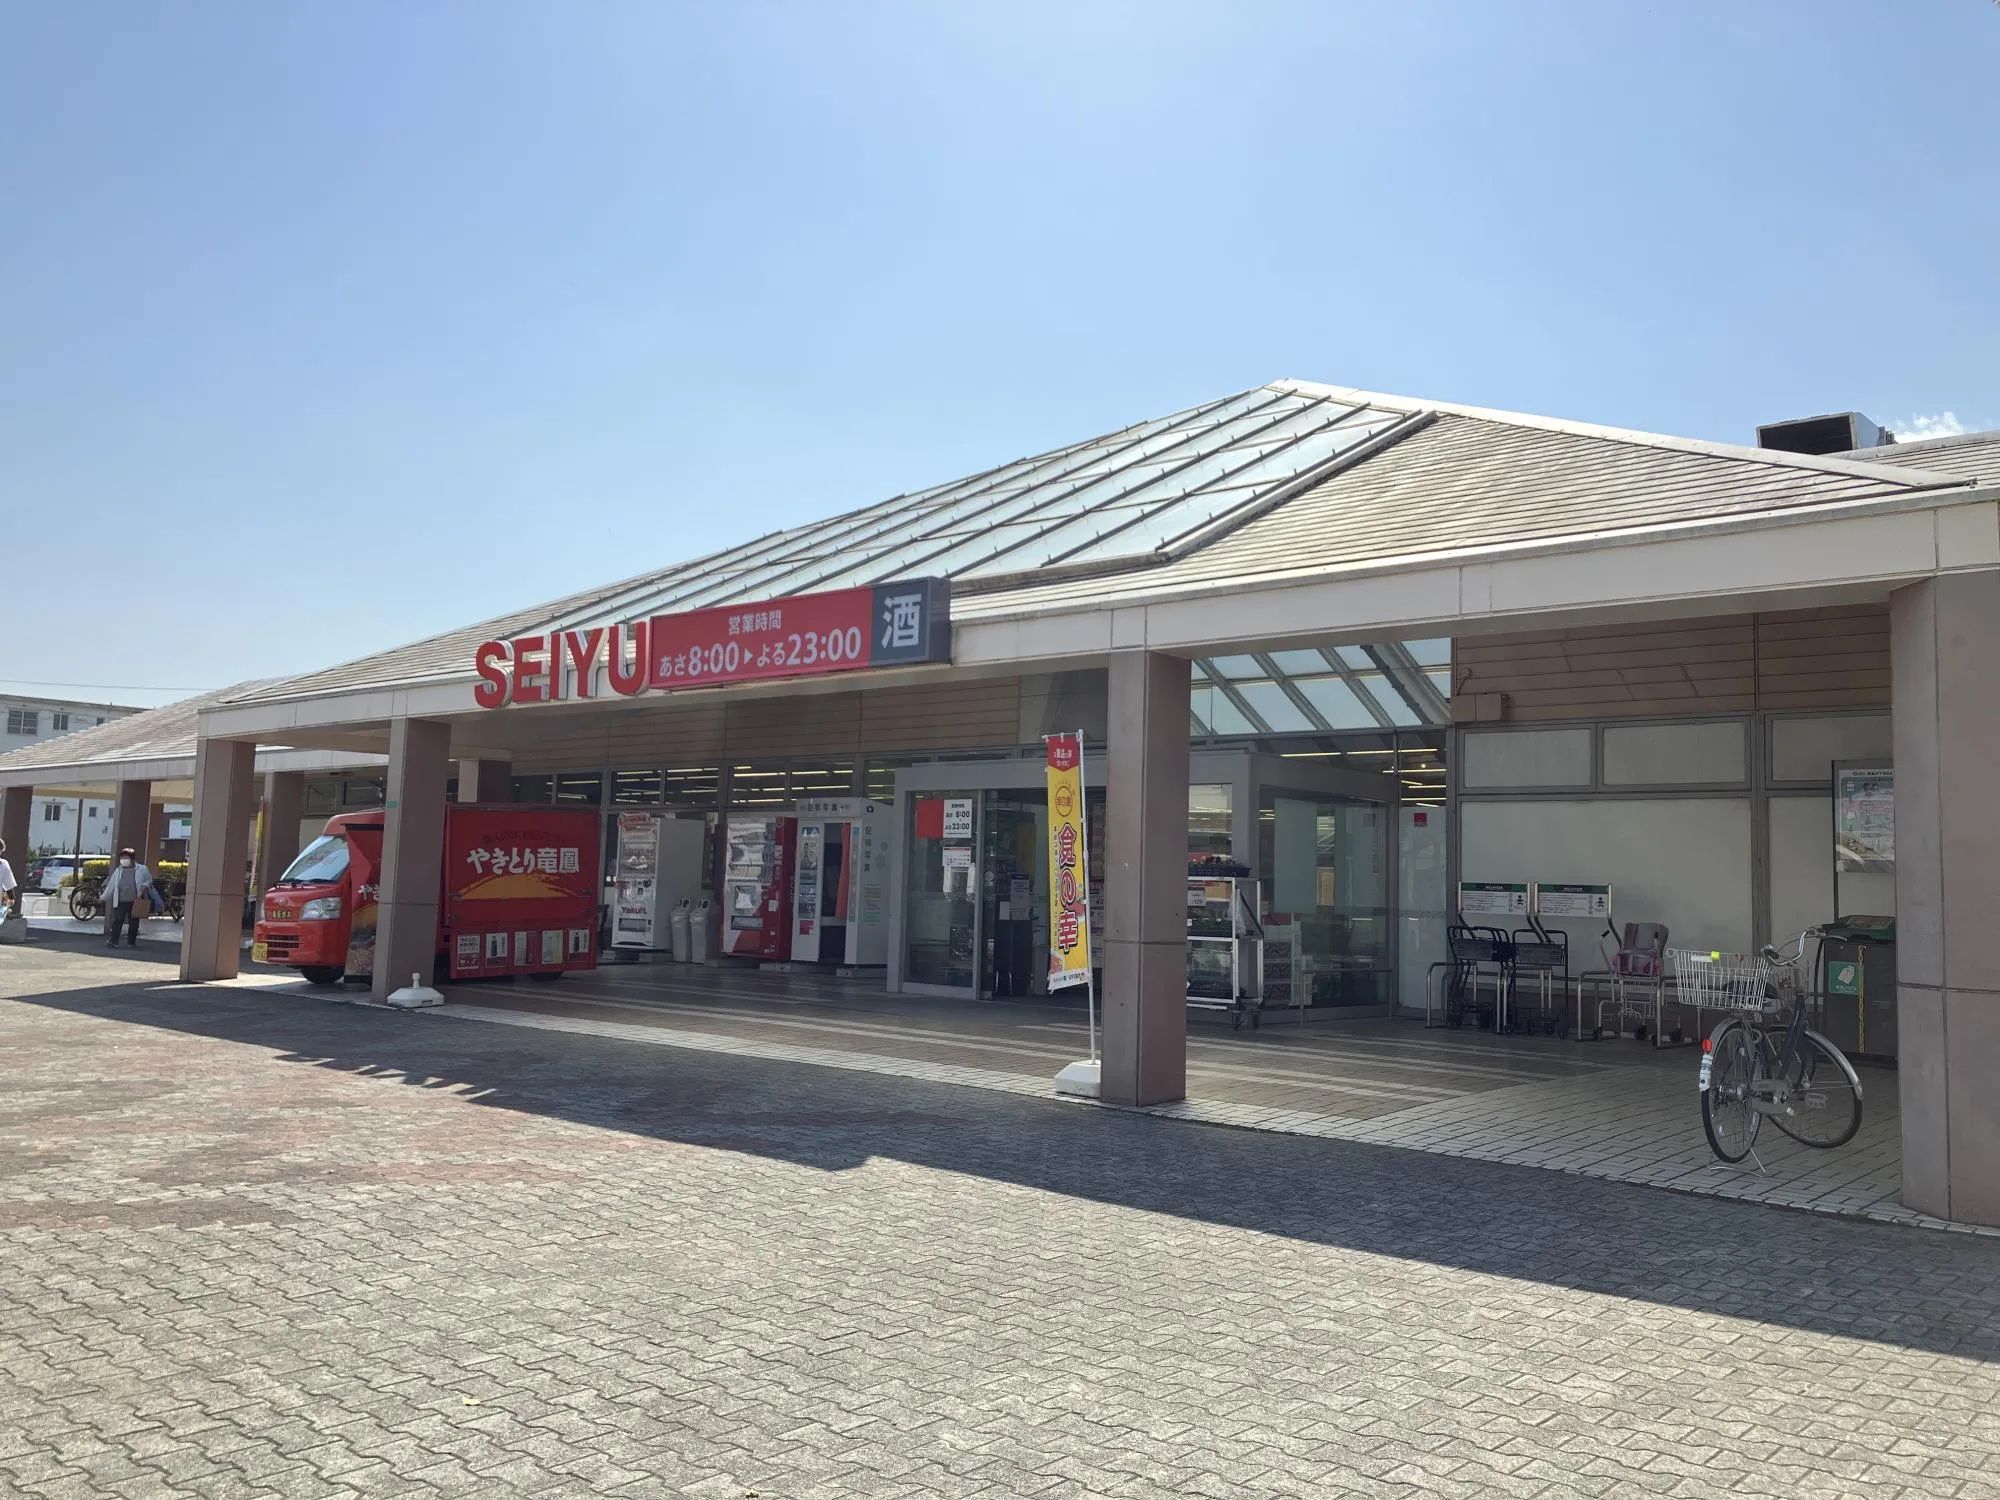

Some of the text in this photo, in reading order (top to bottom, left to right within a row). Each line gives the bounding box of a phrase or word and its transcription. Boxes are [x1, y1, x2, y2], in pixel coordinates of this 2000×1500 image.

[728, 610, 782, 636] 営業時間
[881, 593, 921, 648] 酒
[474, 621, 648, 709] SEIYU
[466, 847, 580, 875] やきとり竜鳳
[621, 905, 647, 915] Yakult
